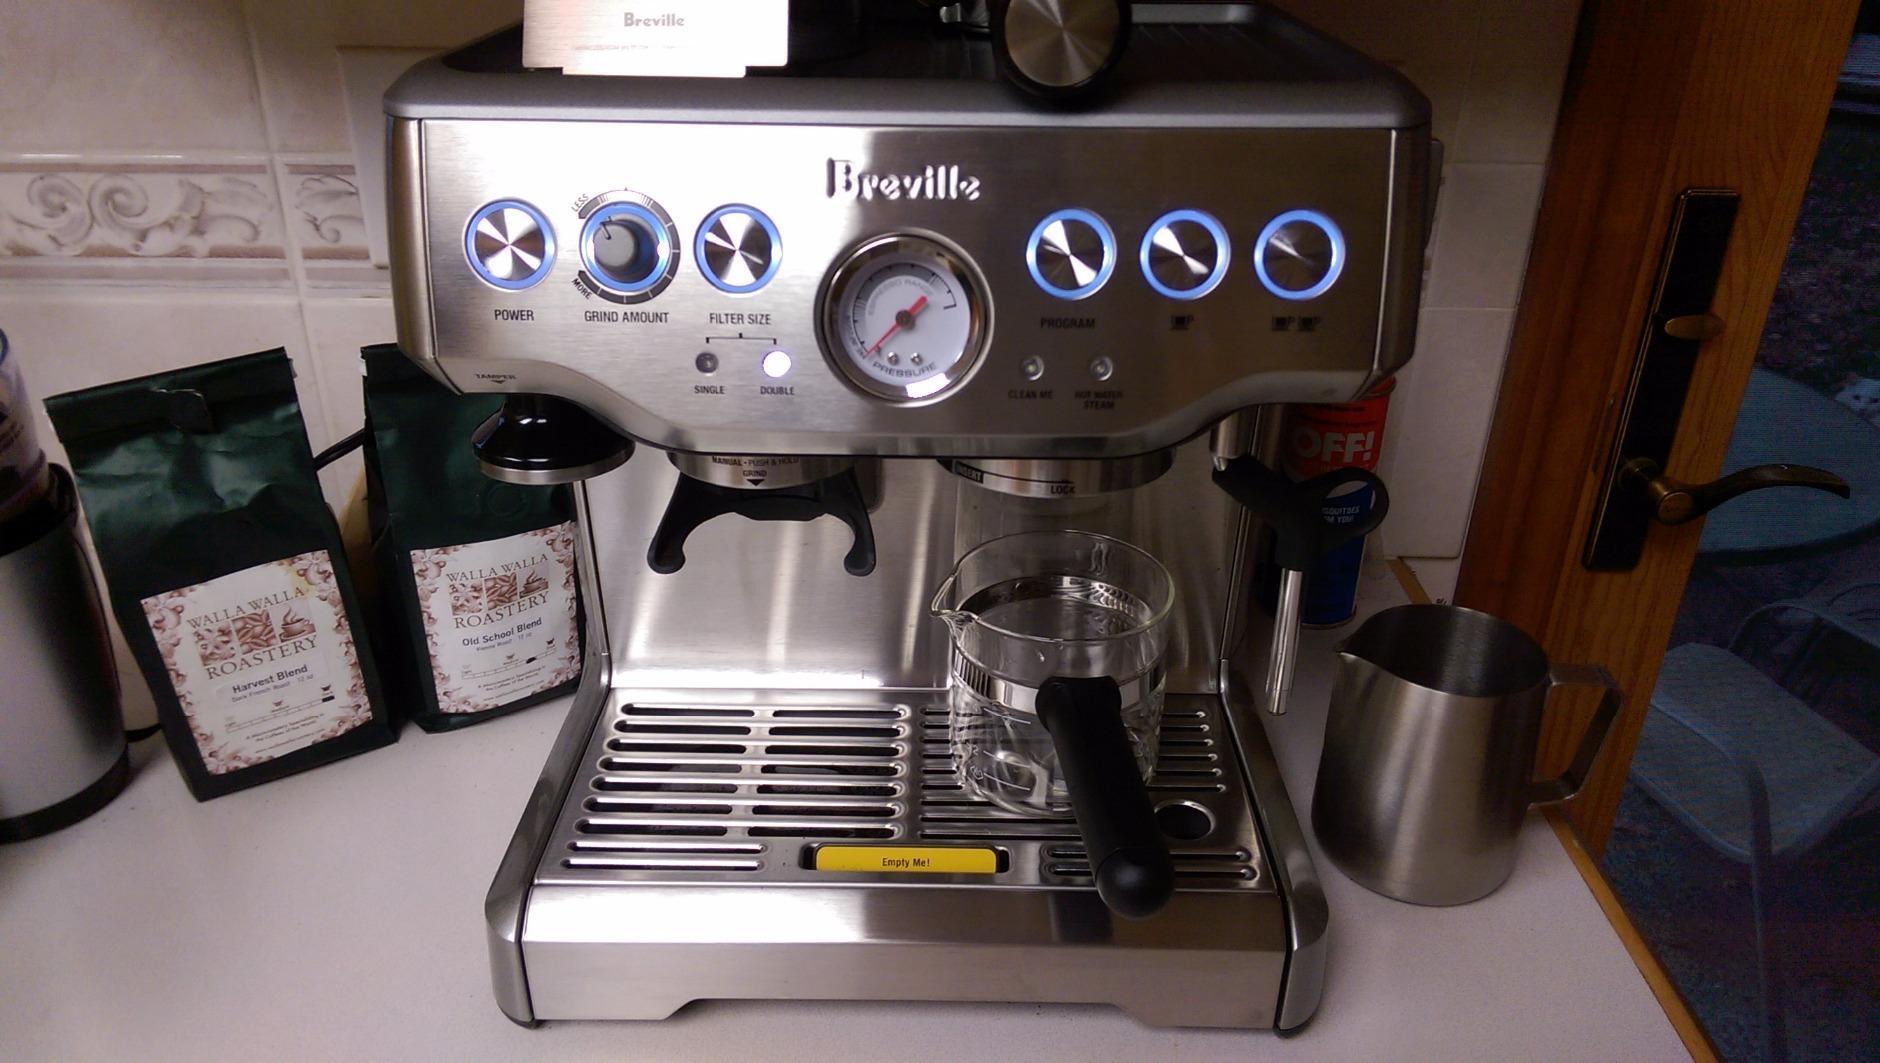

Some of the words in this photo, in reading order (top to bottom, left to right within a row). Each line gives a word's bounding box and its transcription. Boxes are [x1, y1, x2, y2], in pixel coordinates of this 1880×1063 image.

[623, 11, 685, 28] Breville
[825, 156, 981, 201] Breville
[570, 193, 589, 213] LESS
[571, 278, 593, 300] MORE
[493, 309, 535, 321] POWER
[584, 310, 619, 322] GRIND
[621, 311, 670, 324] AMOUNT
[709, 312, 745, 325] FILTER
[747, 313, 772, 325] SIZE
[1040, 317, 1096, 330] PROGRAM
[872, 361, 937, 378] PRESSURE
[693, 384, 726, 396] SINGLE
[759, 385, 795, 396] DOUBLE
[1007, 389, 1037, 400] CLEAN
[1038, 389, 1053, 400] ME
[1074, 389, 1091, 400] HOT
[1093, 390, 1124, 401] WATER
[1083, 400, 1115, 411] STEAM
[1293, 427, 1376, 464] OFF!
[1050, 484, 1076, 496] LOCK
[1321, 504, 1361, 516] SQUITOES
[446, 567, 498, 584] WALLA
[500, 553, 550, 572] WALLA
[186, 604, 246, 630] WALLA
[247, 586, 306, 611] WALLA
[453, 591, 550, 630] ROASTERY
[462, 637, 480, 647] Old
[482, 627, 515, 644] School
[516, 616, 543, 633] Blend
[205, 634, 319, 680] ROASTERY
[232, 674, 275, 695] Harvest
[276, 664, 309, 681] Blend
[881, 857, 910, 869] Empty
[912, 857, 931, 868] Me!
